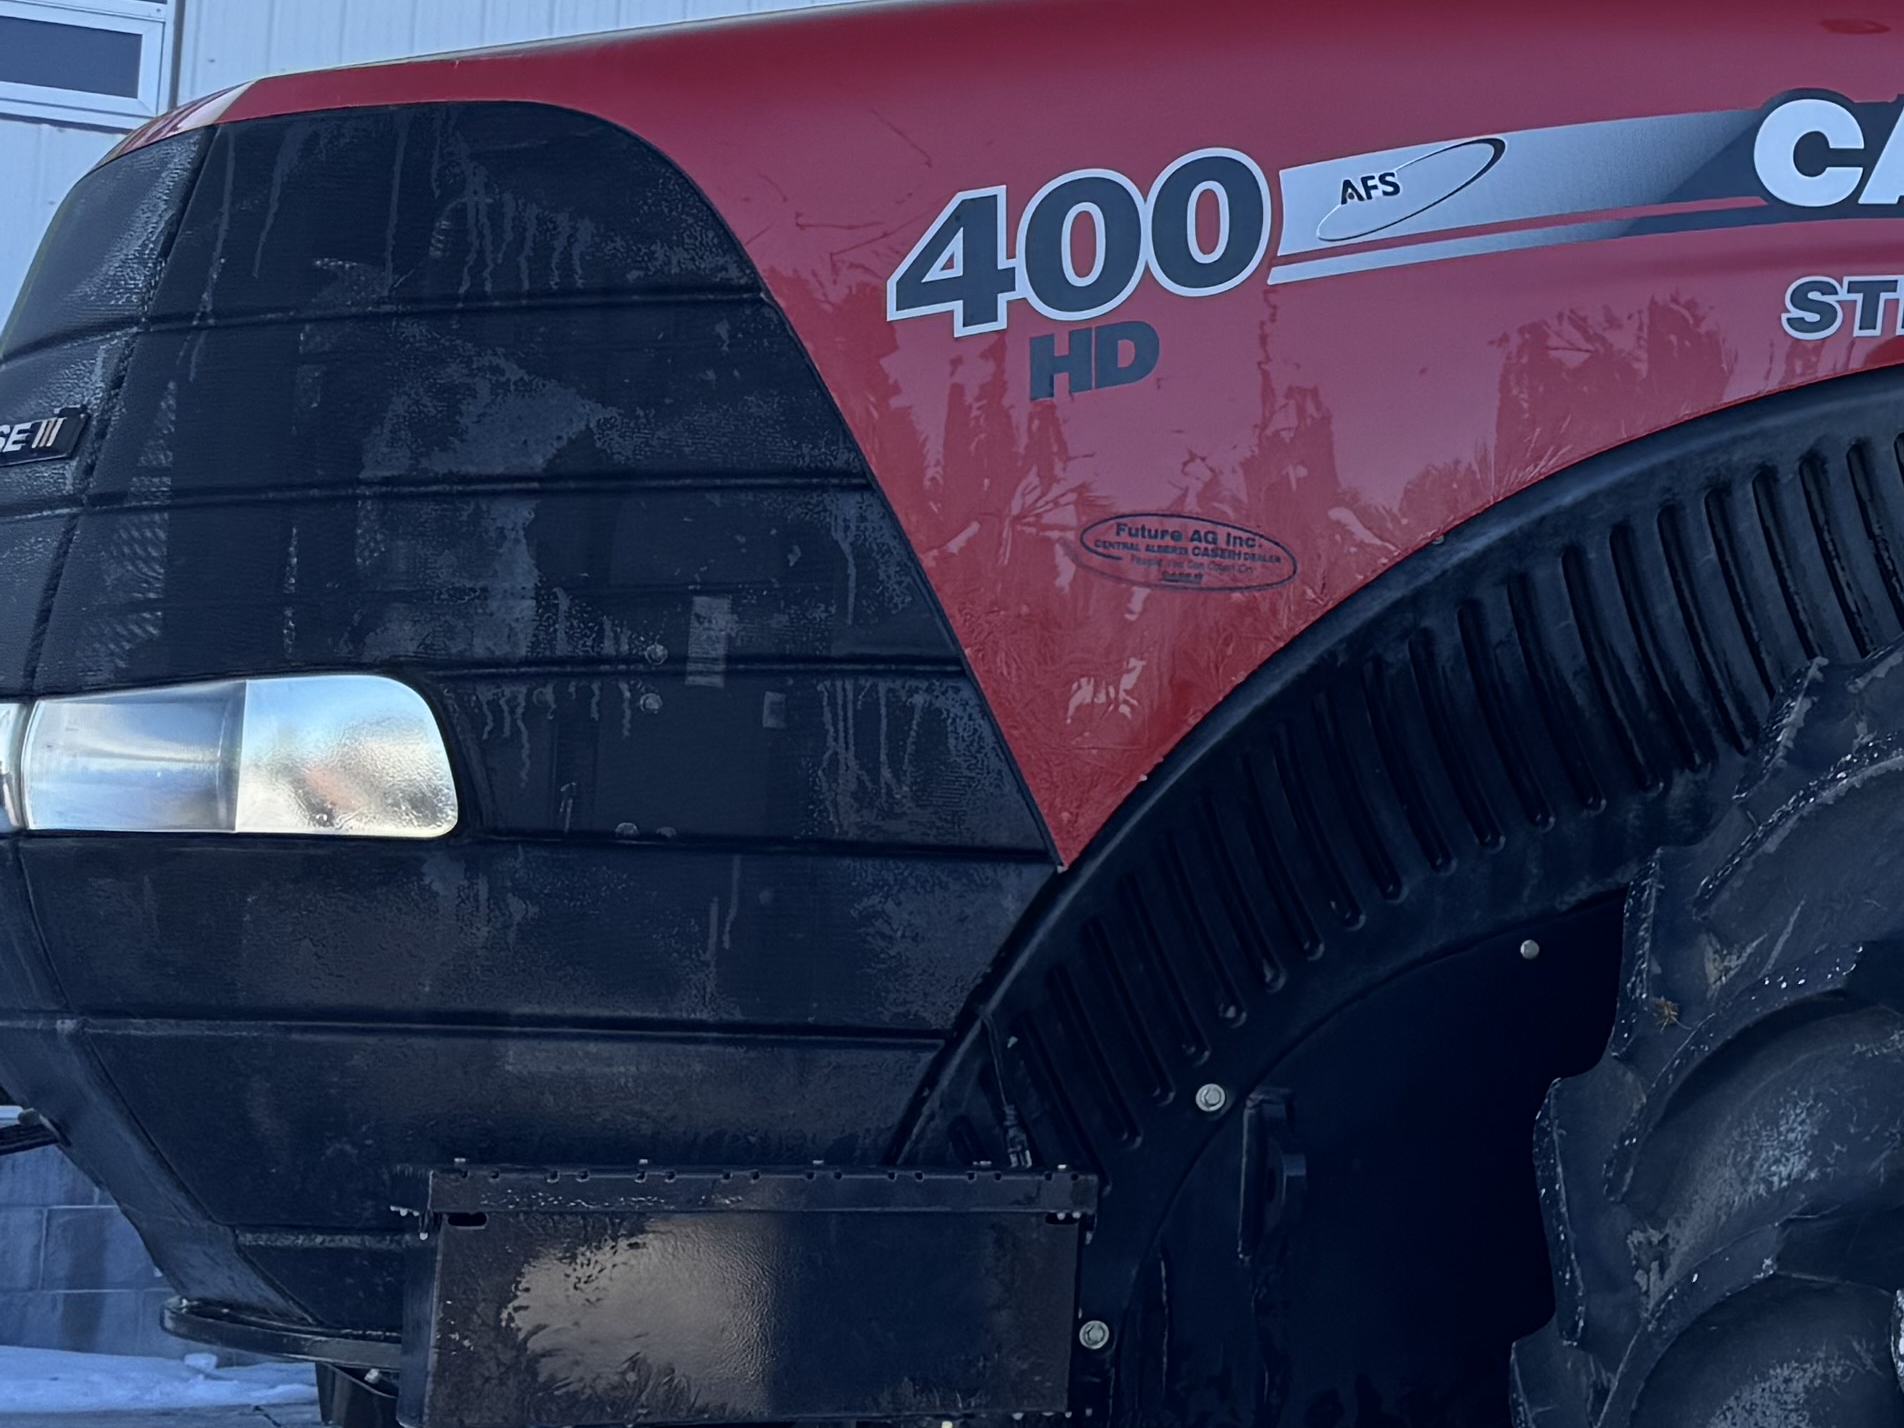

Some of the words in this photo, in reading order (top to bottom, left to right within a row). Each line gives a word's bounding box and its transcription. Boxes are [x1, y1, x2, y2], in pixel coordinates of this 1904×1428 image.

[1339, 171, 1402, 205] AFS
[886, 147, 1271, 337] 400
[1029, 321, 1161, 401] HD
[1115, 522, 1183, 542] Future
[1190, 529, 1218, 545] AG
[1225, 531, 1263, 548] Inc.
